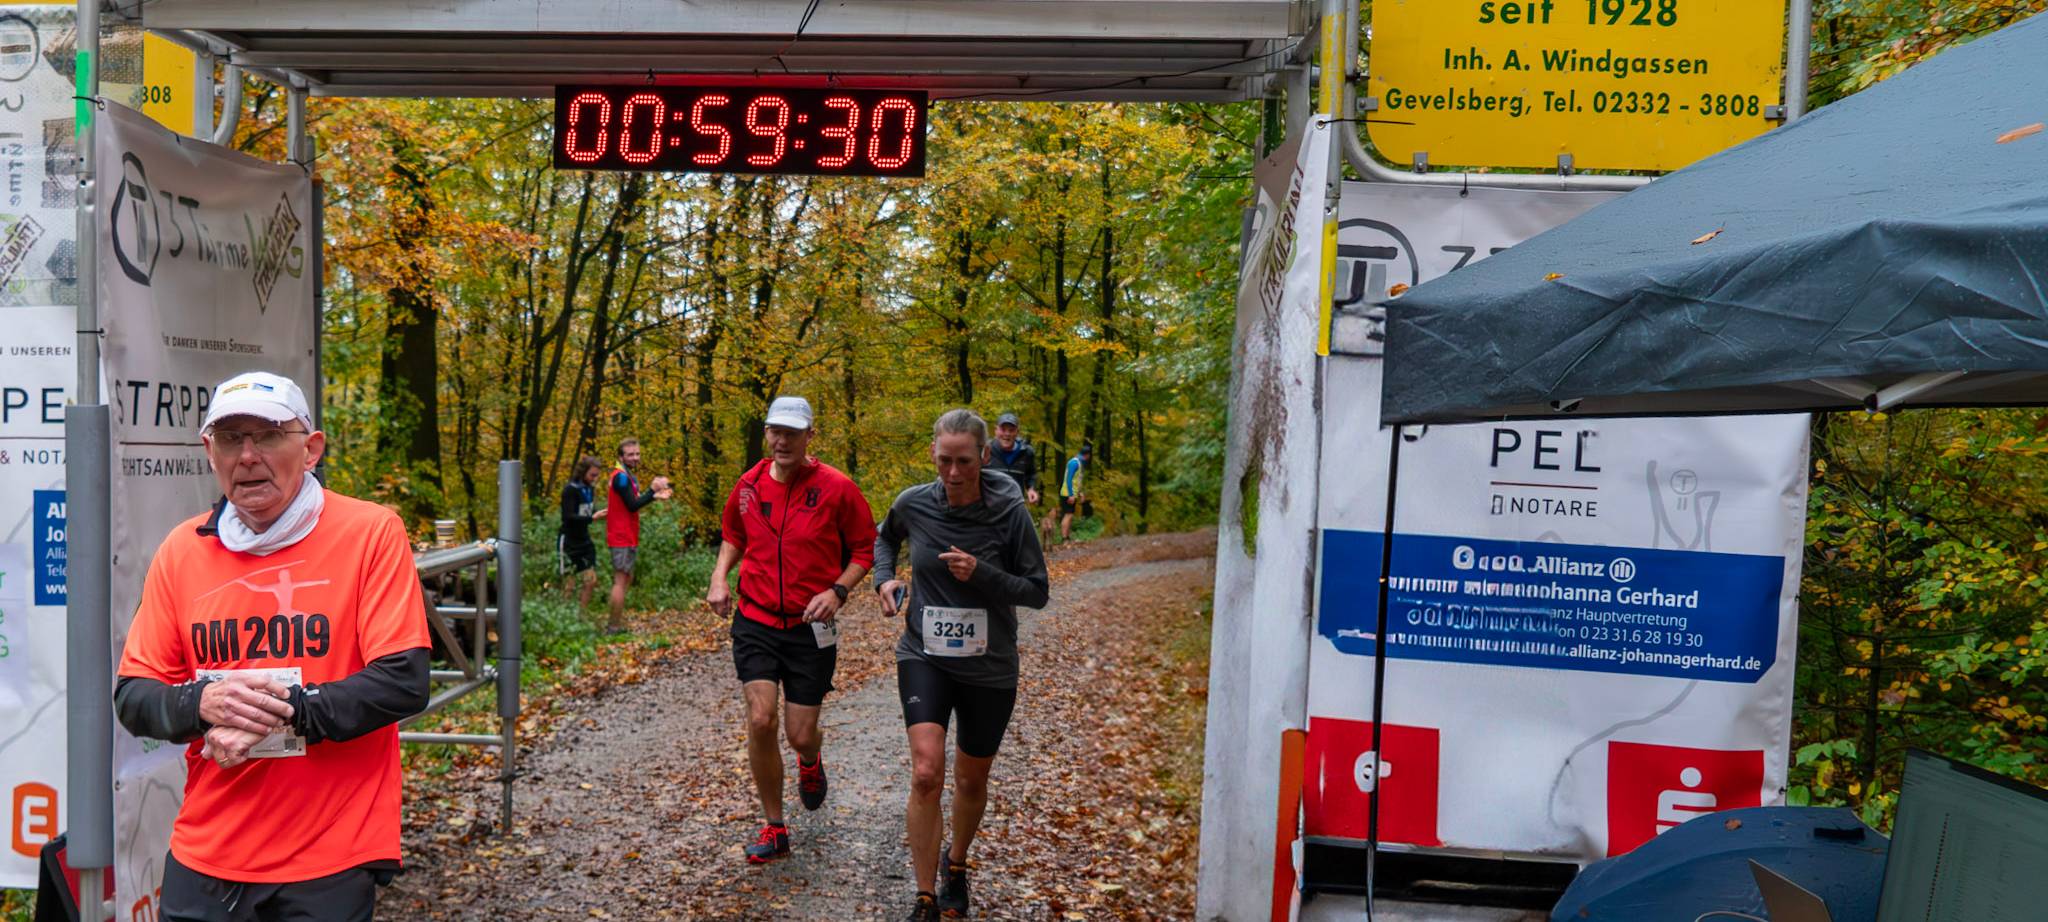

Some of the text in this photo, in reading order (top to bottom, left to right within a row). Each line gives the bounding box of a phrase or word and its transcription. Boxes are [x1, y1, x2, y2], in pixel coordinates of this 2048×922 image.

[1479, 0, 1678, 27] seit 1928
[1444, 48, 1708, 78] Inh. A. Windgassen
[1385, 88, 1532, 117] Gevelsberg,
[1543, 91, 1582, 113] Tel.
[1593, 92, 1670, 114] 02332
[1699, 94, 1760, 116] 3808
[565, 93, 915, 169] 00:59:30
[11, 347, 71, 356] UNSEREN
[23, 450, 66, 464] NOT
[1511, 497, 1597, 517] NOTARE
[46, 526, 66, 542] Jo
[1535, 556, 1605, 577] Allianz
[1616, 587, 1699, 609] Gerhard
[933, 621, 976, 638] 3234
[1576, 608, 1687, 631] Hauptvertretung
[191, 613, 330, 665] DM 2019
[1580, 627, 1589, 639] 0
[1592, 627, 1609, 640] 23
[1644, 631, 1662, 644] 28
[1667, 632, 1682, 646] 19
[1685, 634, 1704, 648] 30
